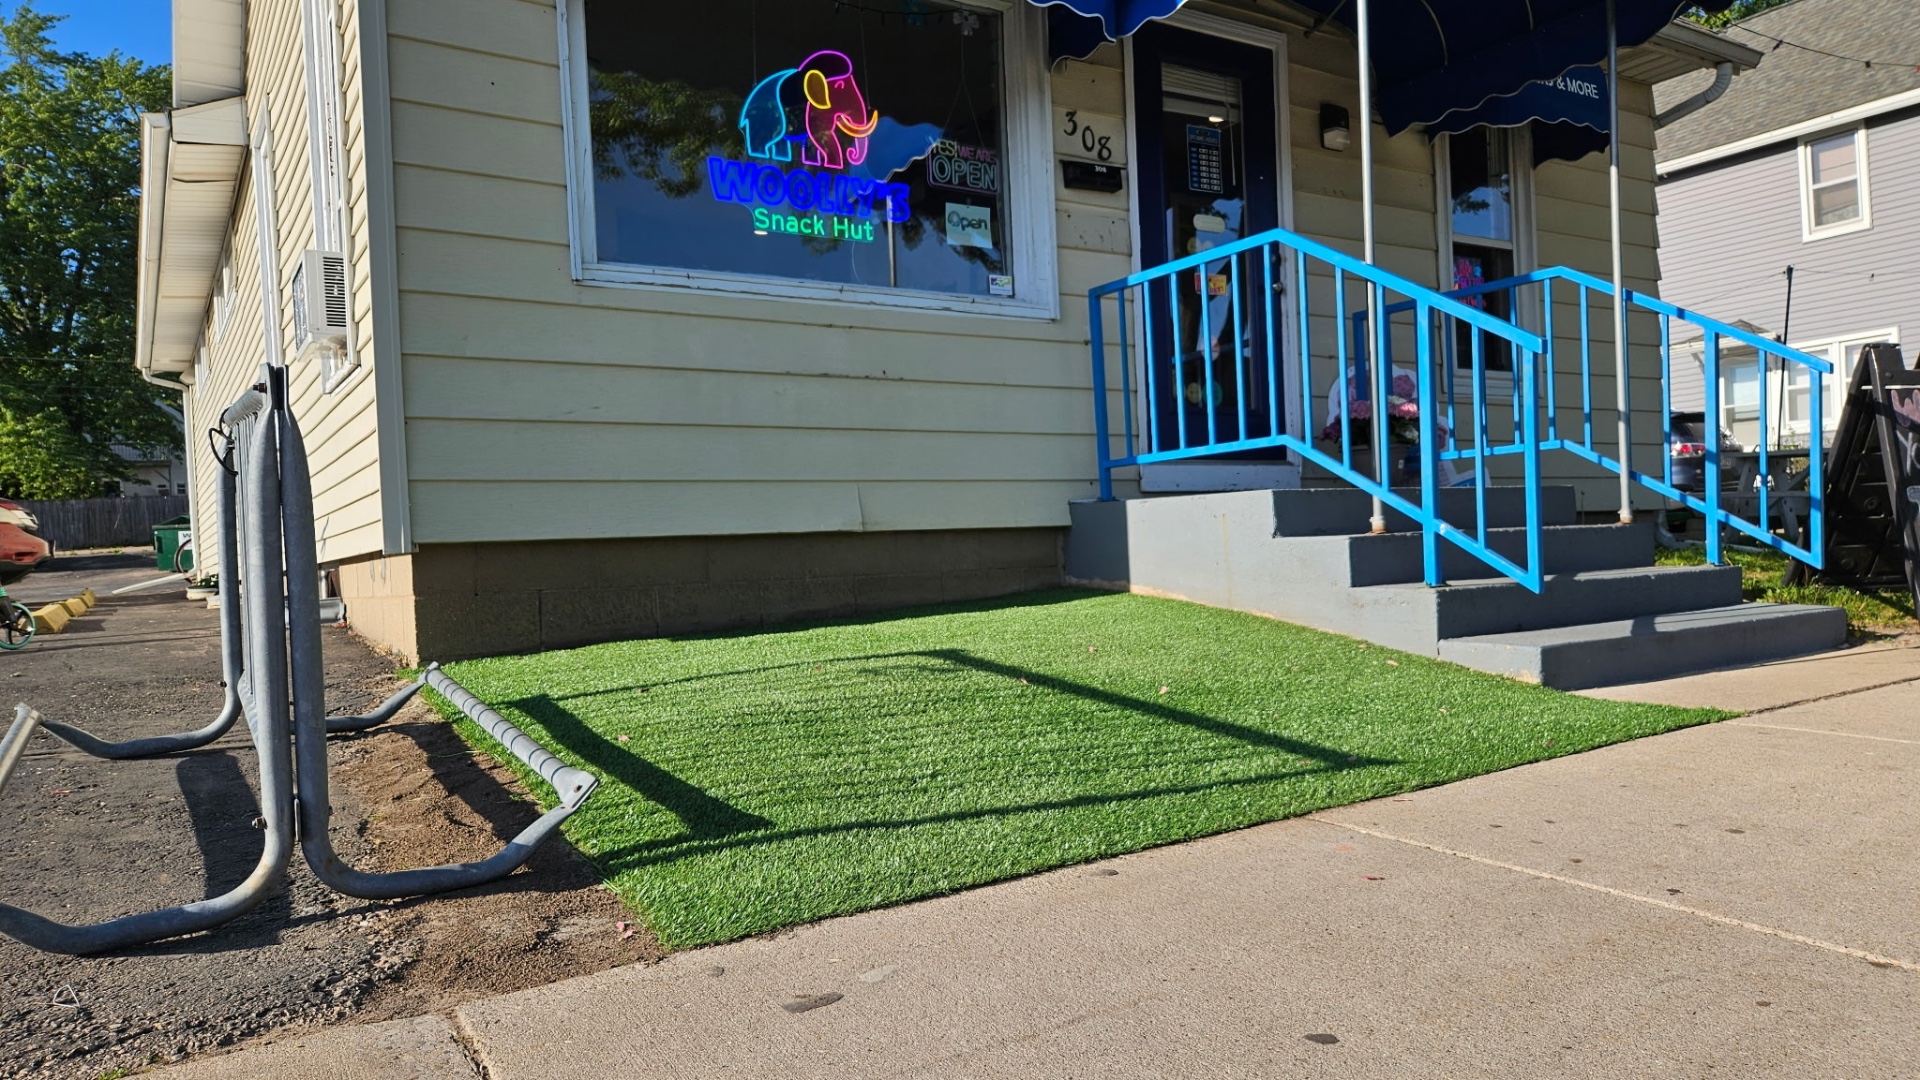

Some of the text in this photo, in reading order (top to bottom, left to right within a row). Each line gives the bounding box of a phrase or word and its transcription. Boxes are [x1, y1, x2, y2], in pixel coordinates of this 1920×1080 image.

[1556, 75, 1566, 91] &
[1566, 77, 1599, 99] MORE
[958, 145, 975, 159] WE
[1063, 110, 1112, 162] 308
[707, 156, 911, 223] WOOLLY'S
[933, 155, 997, 191] OPEN
[754, 207, 874, 241] Snack Hut
[947, 210, 988, 232] Open
